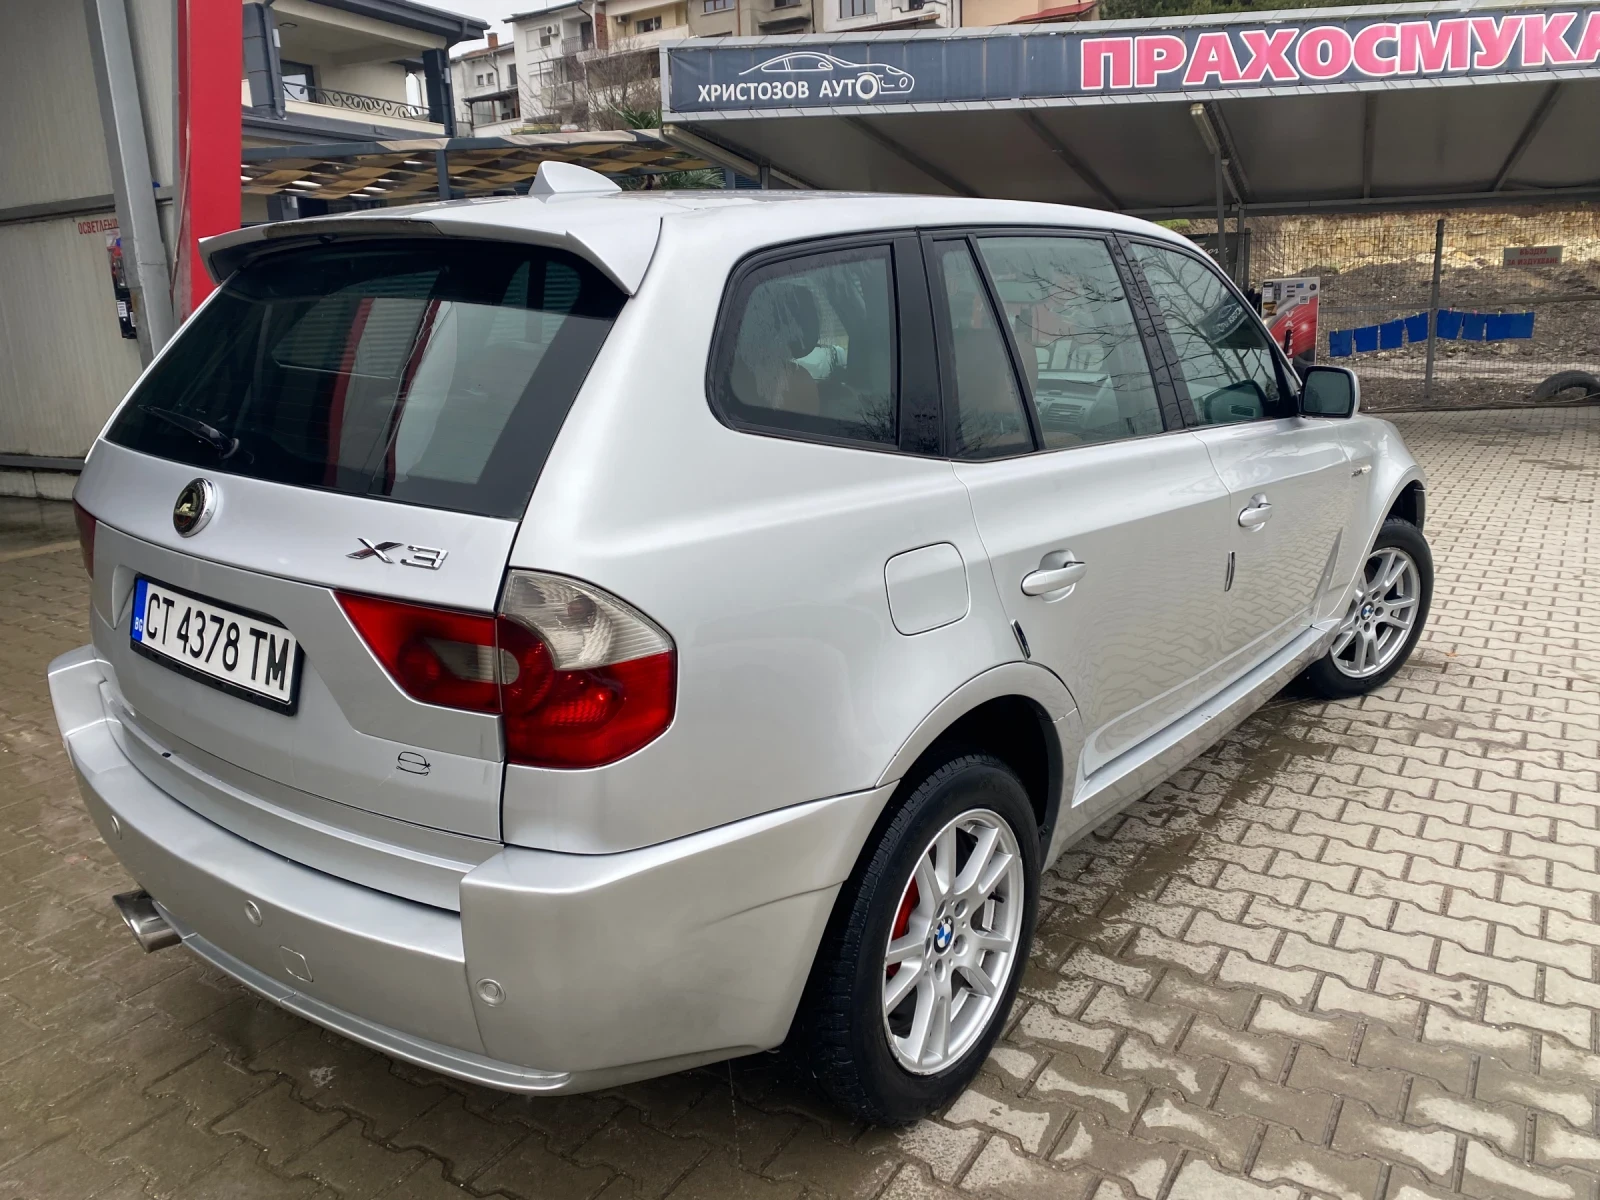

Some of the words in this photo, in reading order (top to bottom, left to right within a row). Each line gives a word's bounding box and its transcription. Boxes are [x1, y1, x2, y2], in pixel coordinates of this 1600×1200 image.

[698, 80, 810, 102] ХРИСТОЗОВ
[819, 74, 878, 99] АУТО
[1517, 257, 1558, 265] ИЗДУХВАНЕ
[1519, 247, 1548, 255] ВЪЗДУХ
[345, 537, 449, 571] X3
[134, 616, 144, 632] BG
[146, 592, 175, 646] CT
[177, 606, 240, 672] 4378
[249, 627, 290, 691] TM
